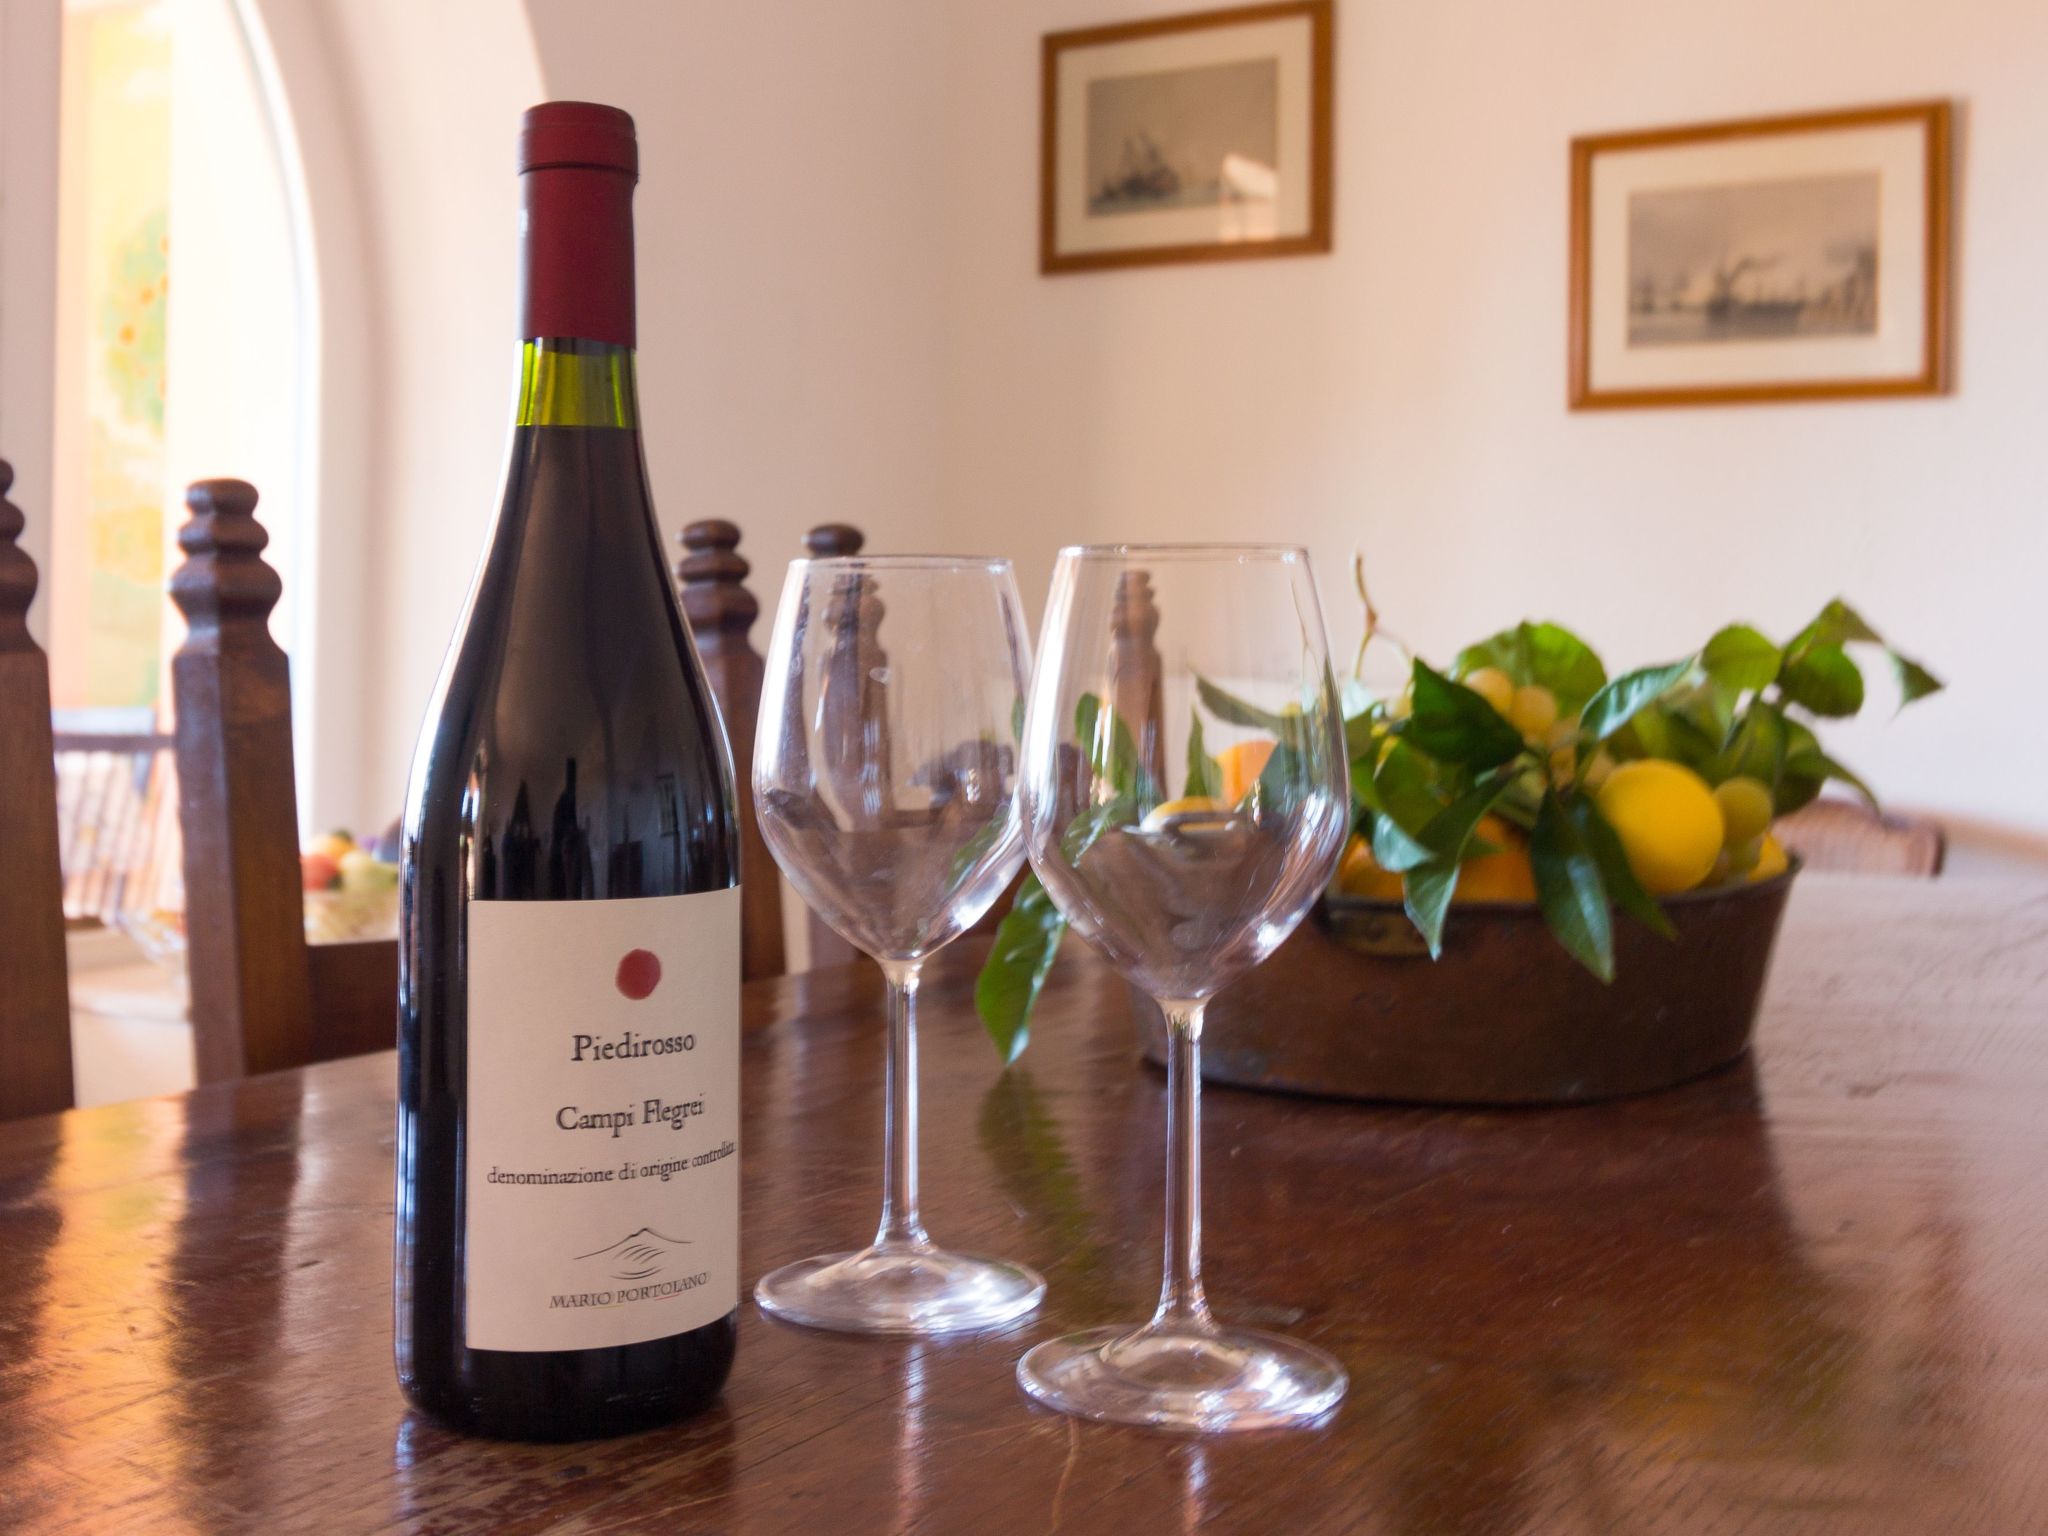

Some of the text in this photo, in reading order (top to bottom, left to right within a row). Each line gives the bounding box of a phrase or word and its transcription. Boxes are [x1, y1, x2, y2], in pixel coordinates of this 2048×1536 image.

[571, 1031, 696, 1061] Piedirosso
[556, 1093, 705, 1138] Campi Flegrei
[487, 1167, 613, 1185] denominazione
[618, 1163, 636, 1181] di
[640, 1157, 688, 1181] origine
[549, 1272, 709, 1308] MARIO PORTOLANO
